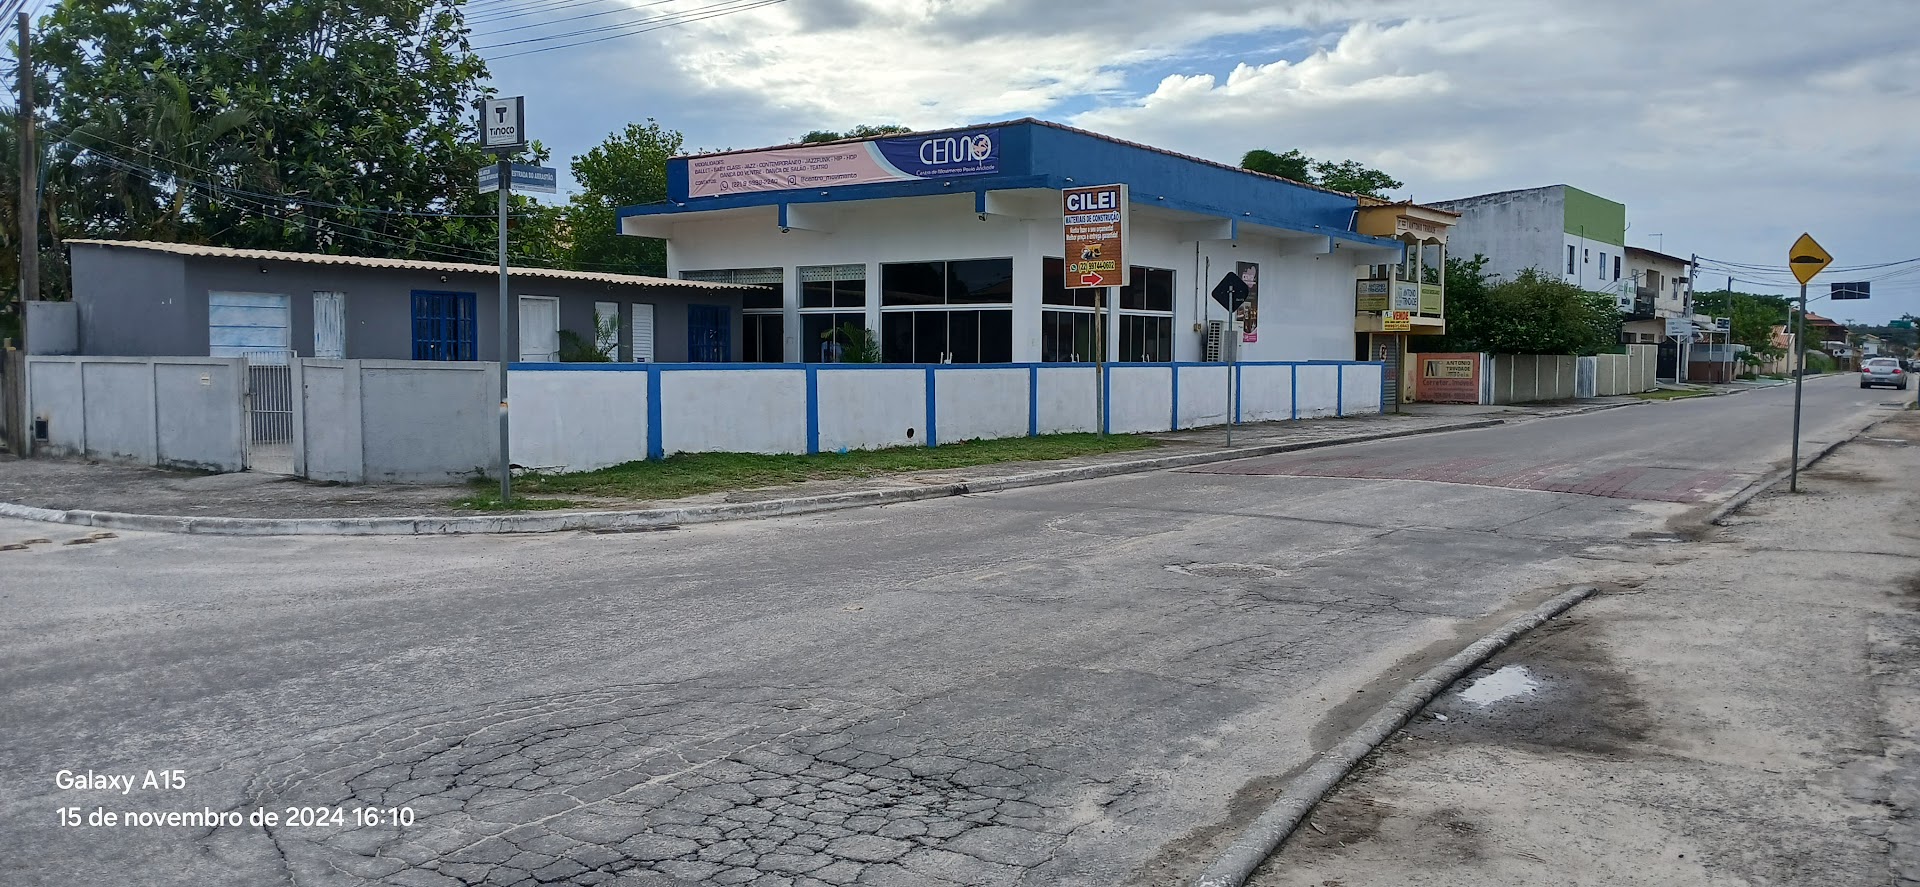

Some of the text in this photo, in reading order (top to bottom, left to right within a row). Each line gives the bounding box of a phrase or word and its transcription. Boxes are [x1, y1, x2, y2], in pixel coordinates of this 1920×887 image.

[495, 107, 507, 123] T
[1066, 191, 1116, 211] CILEI
[1065, 211, 1120, 224] MATERIAIS DE CONSTRUÇÃO
[1393, 311, 1409, 320] VENDE
